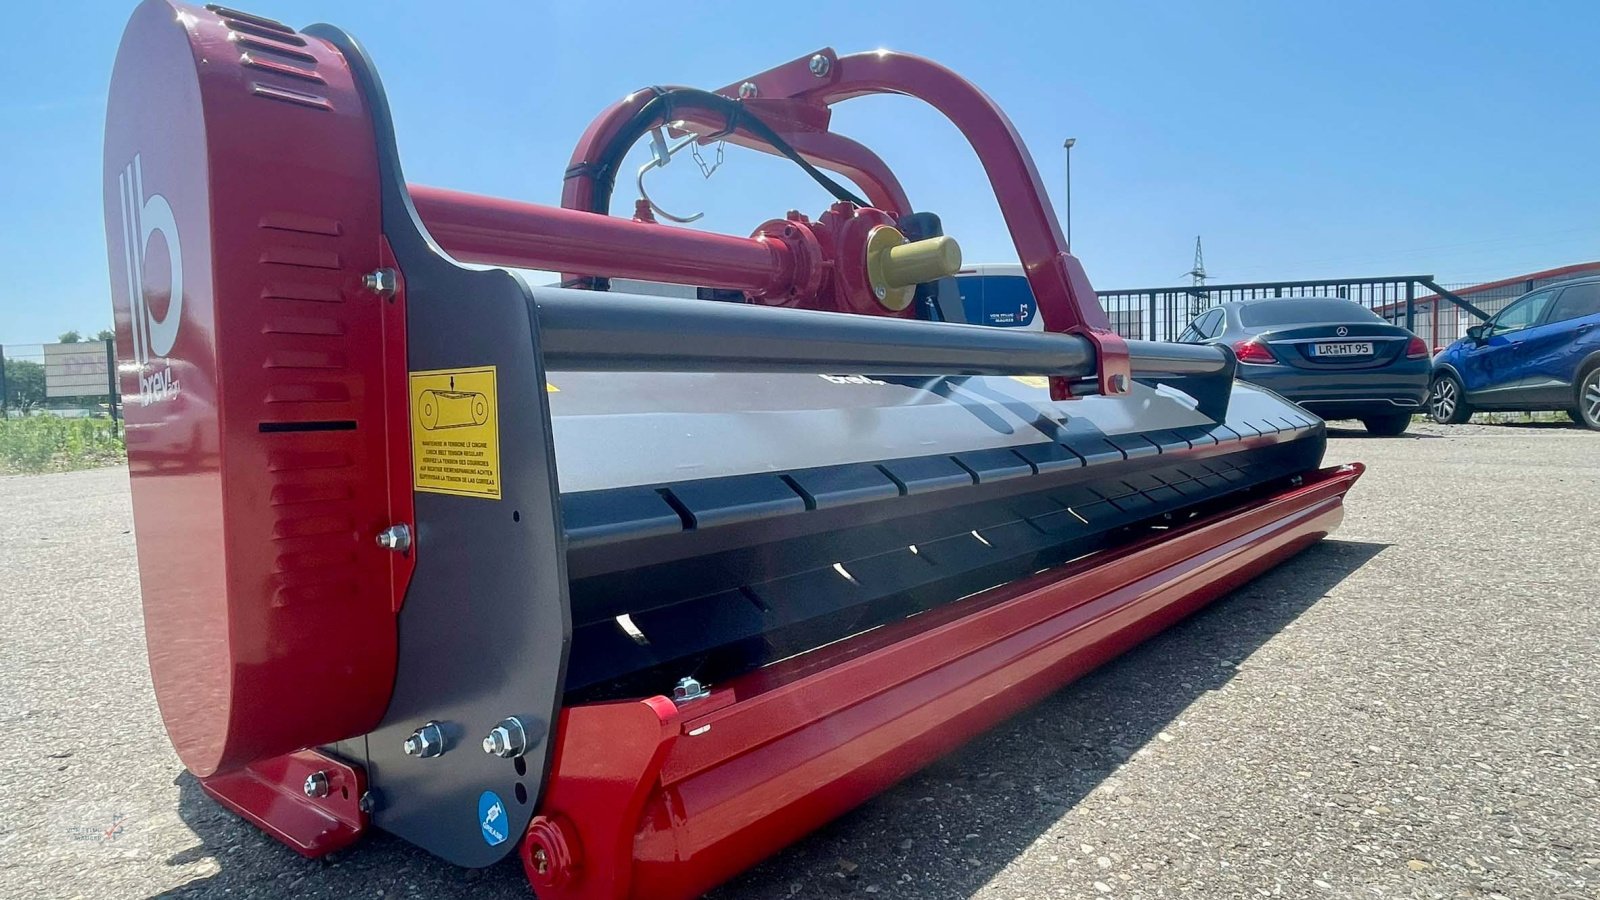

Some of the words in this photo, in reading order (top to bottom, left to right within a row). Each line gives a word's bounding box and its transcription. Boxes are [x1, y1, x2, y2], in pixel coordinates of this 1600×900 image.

[1318, 344, 1333, 355] LR
[1339, 344, 1353, 354] HT
[1355, 343, 1369, 353] 95
